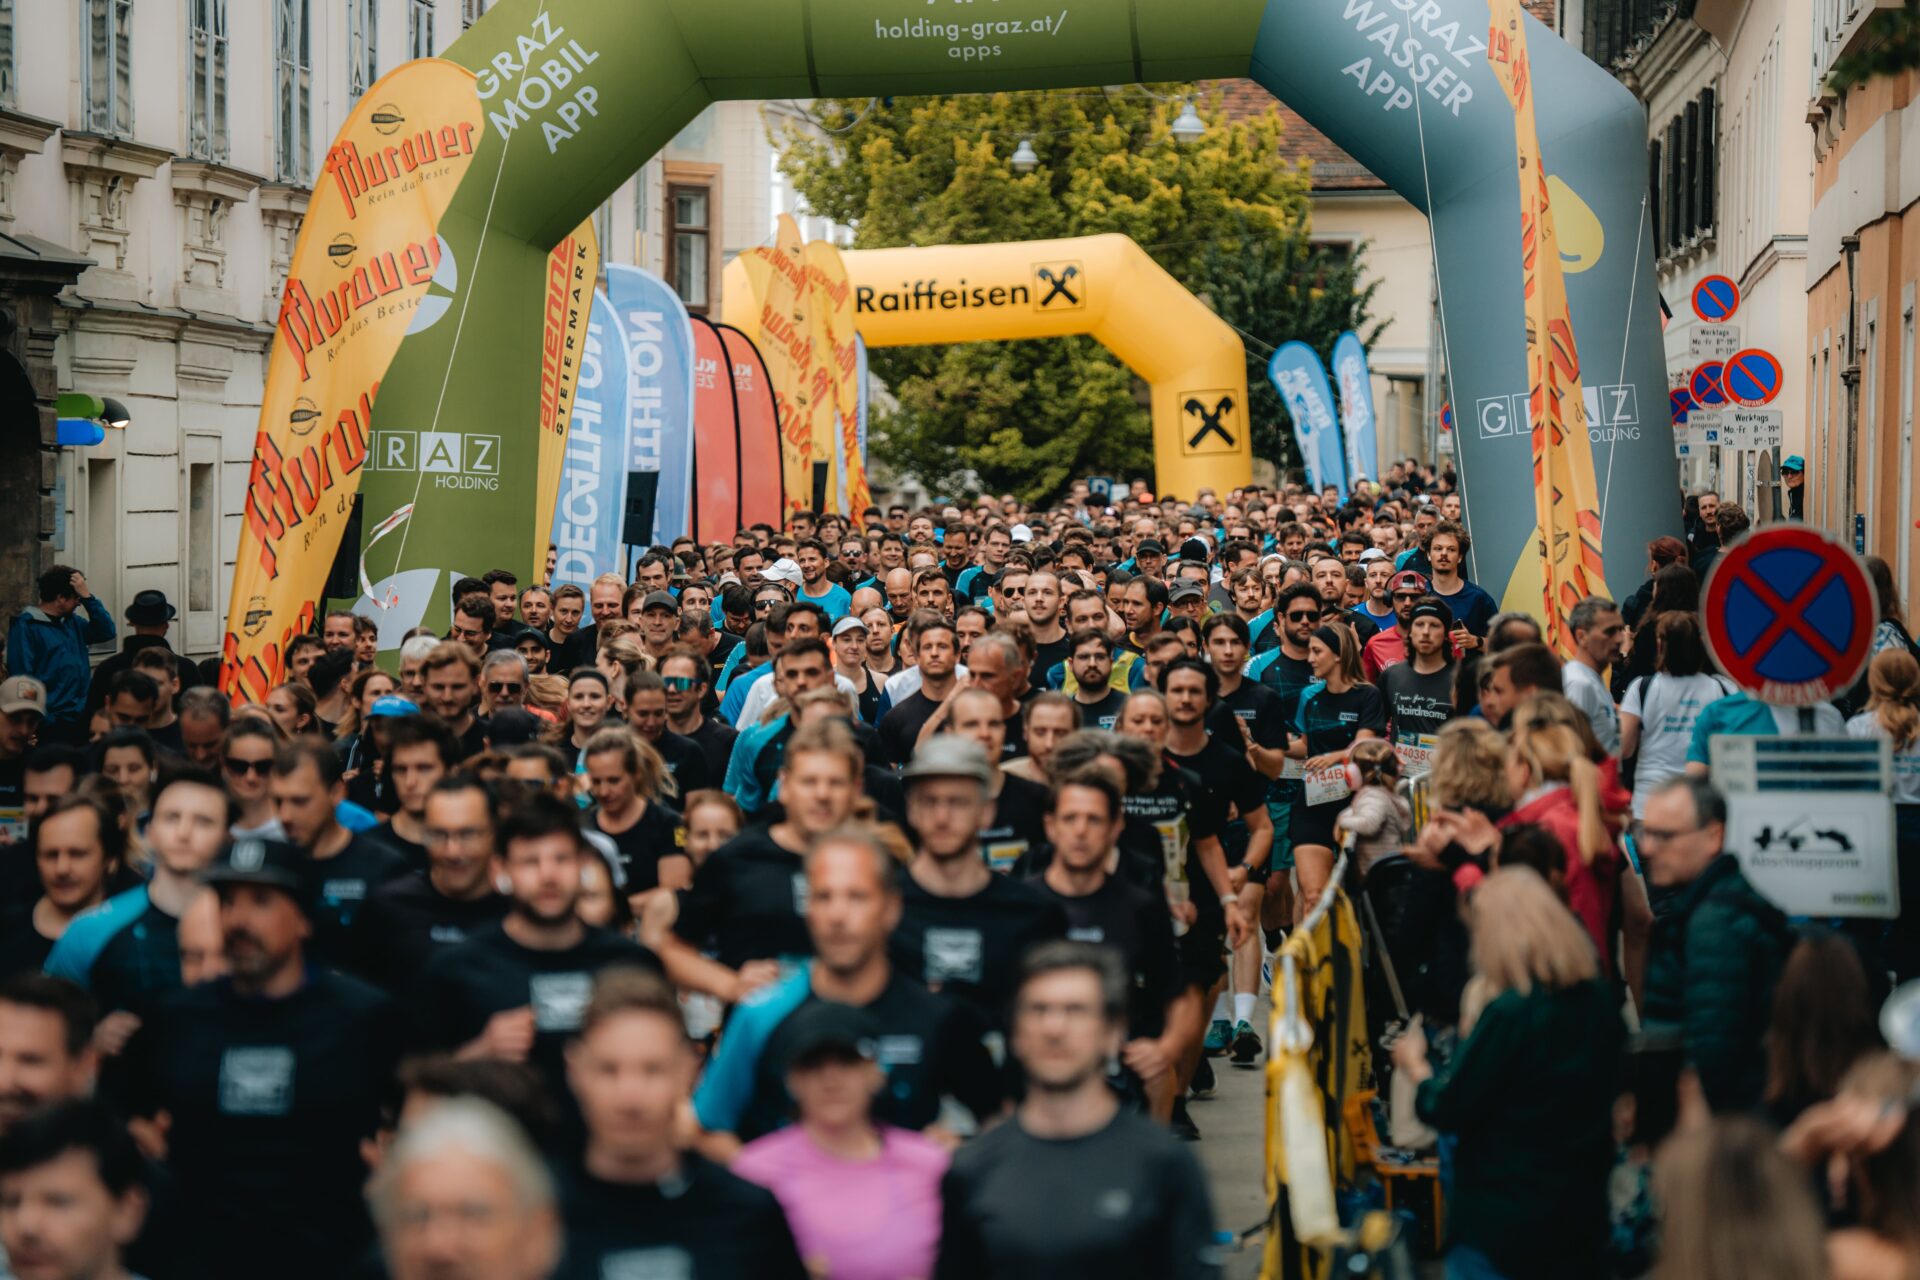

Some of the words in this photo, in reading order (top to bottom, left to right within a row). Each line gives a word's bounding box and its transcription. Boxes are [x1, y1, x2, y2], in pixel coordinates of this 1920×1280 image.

[875, 10, 1068, 41] holding-graz.at/
[476, 11, 564, 99] GRAZ
[948, 45, 1002, 61] apps
[1342, 0, 1474, 117] WASSER
[489, 39, 600, 140] MOBIL
[1340, 56, 1413, 111] APP
[541, 85, 599, 154] APP
[326, 121, 474, 220] Murauer
[855, 278, 1030, 313] Raiffeisen
[556, 244, 588, 436] STEIERMARK
[1589, 426, 1641, 443] OLDING
[1735, 413, 1769, 423] Werktags
[362, 436, 494, 471] RAZ
[435, 475, 500, 491] HOLDING
[1397, 704, 1447, 720] Hairdreams
